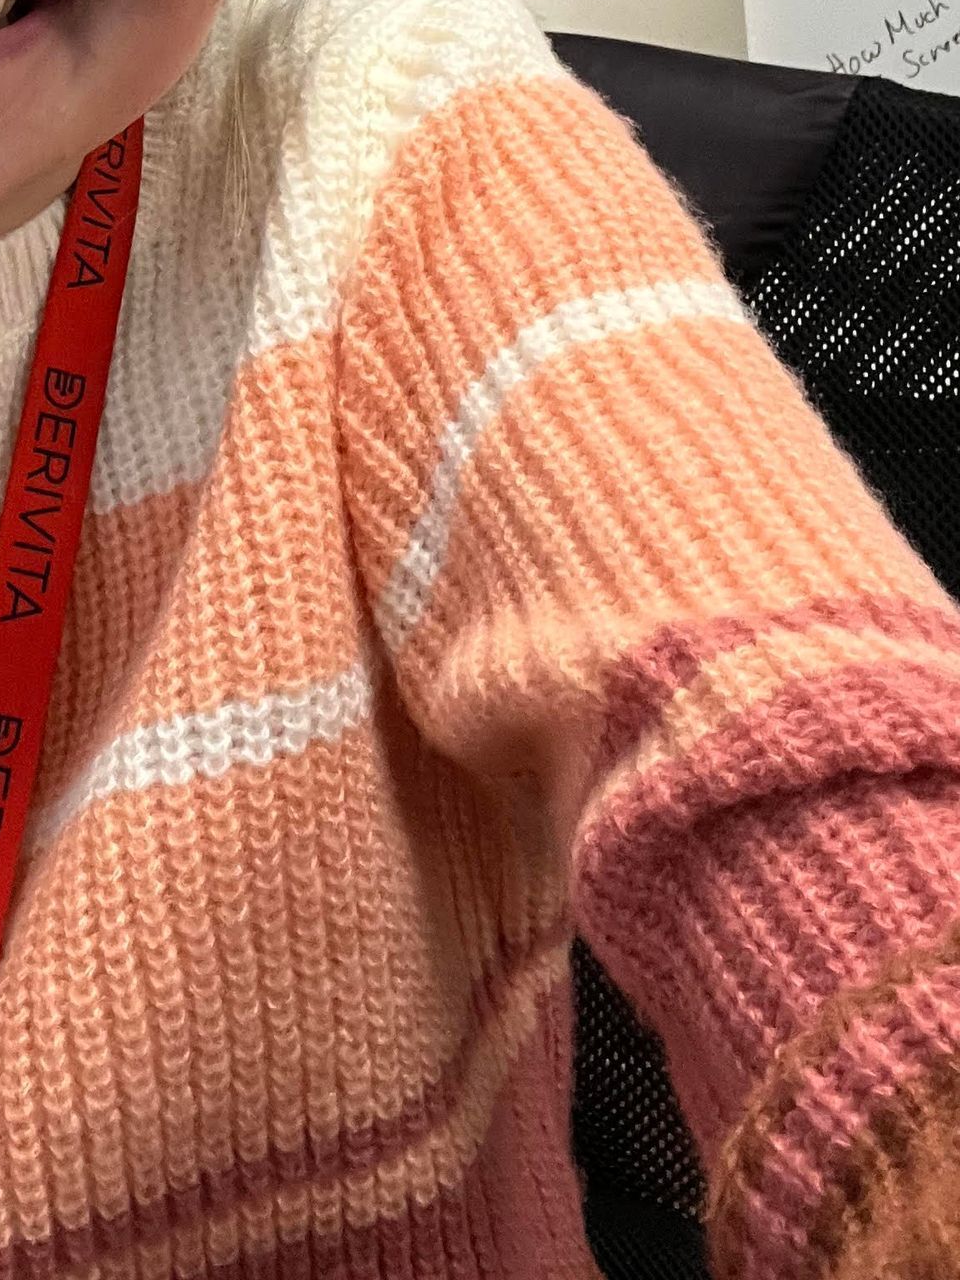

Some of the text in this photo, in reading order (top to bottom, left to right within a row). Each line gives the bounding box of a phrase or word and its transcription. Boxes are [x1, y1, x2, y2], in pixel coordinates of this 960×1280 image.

[826, 41, 881, 74] How
[66, 129, 128, 289] RIVITA
[0, 366, 87, 624] DERIVITA
